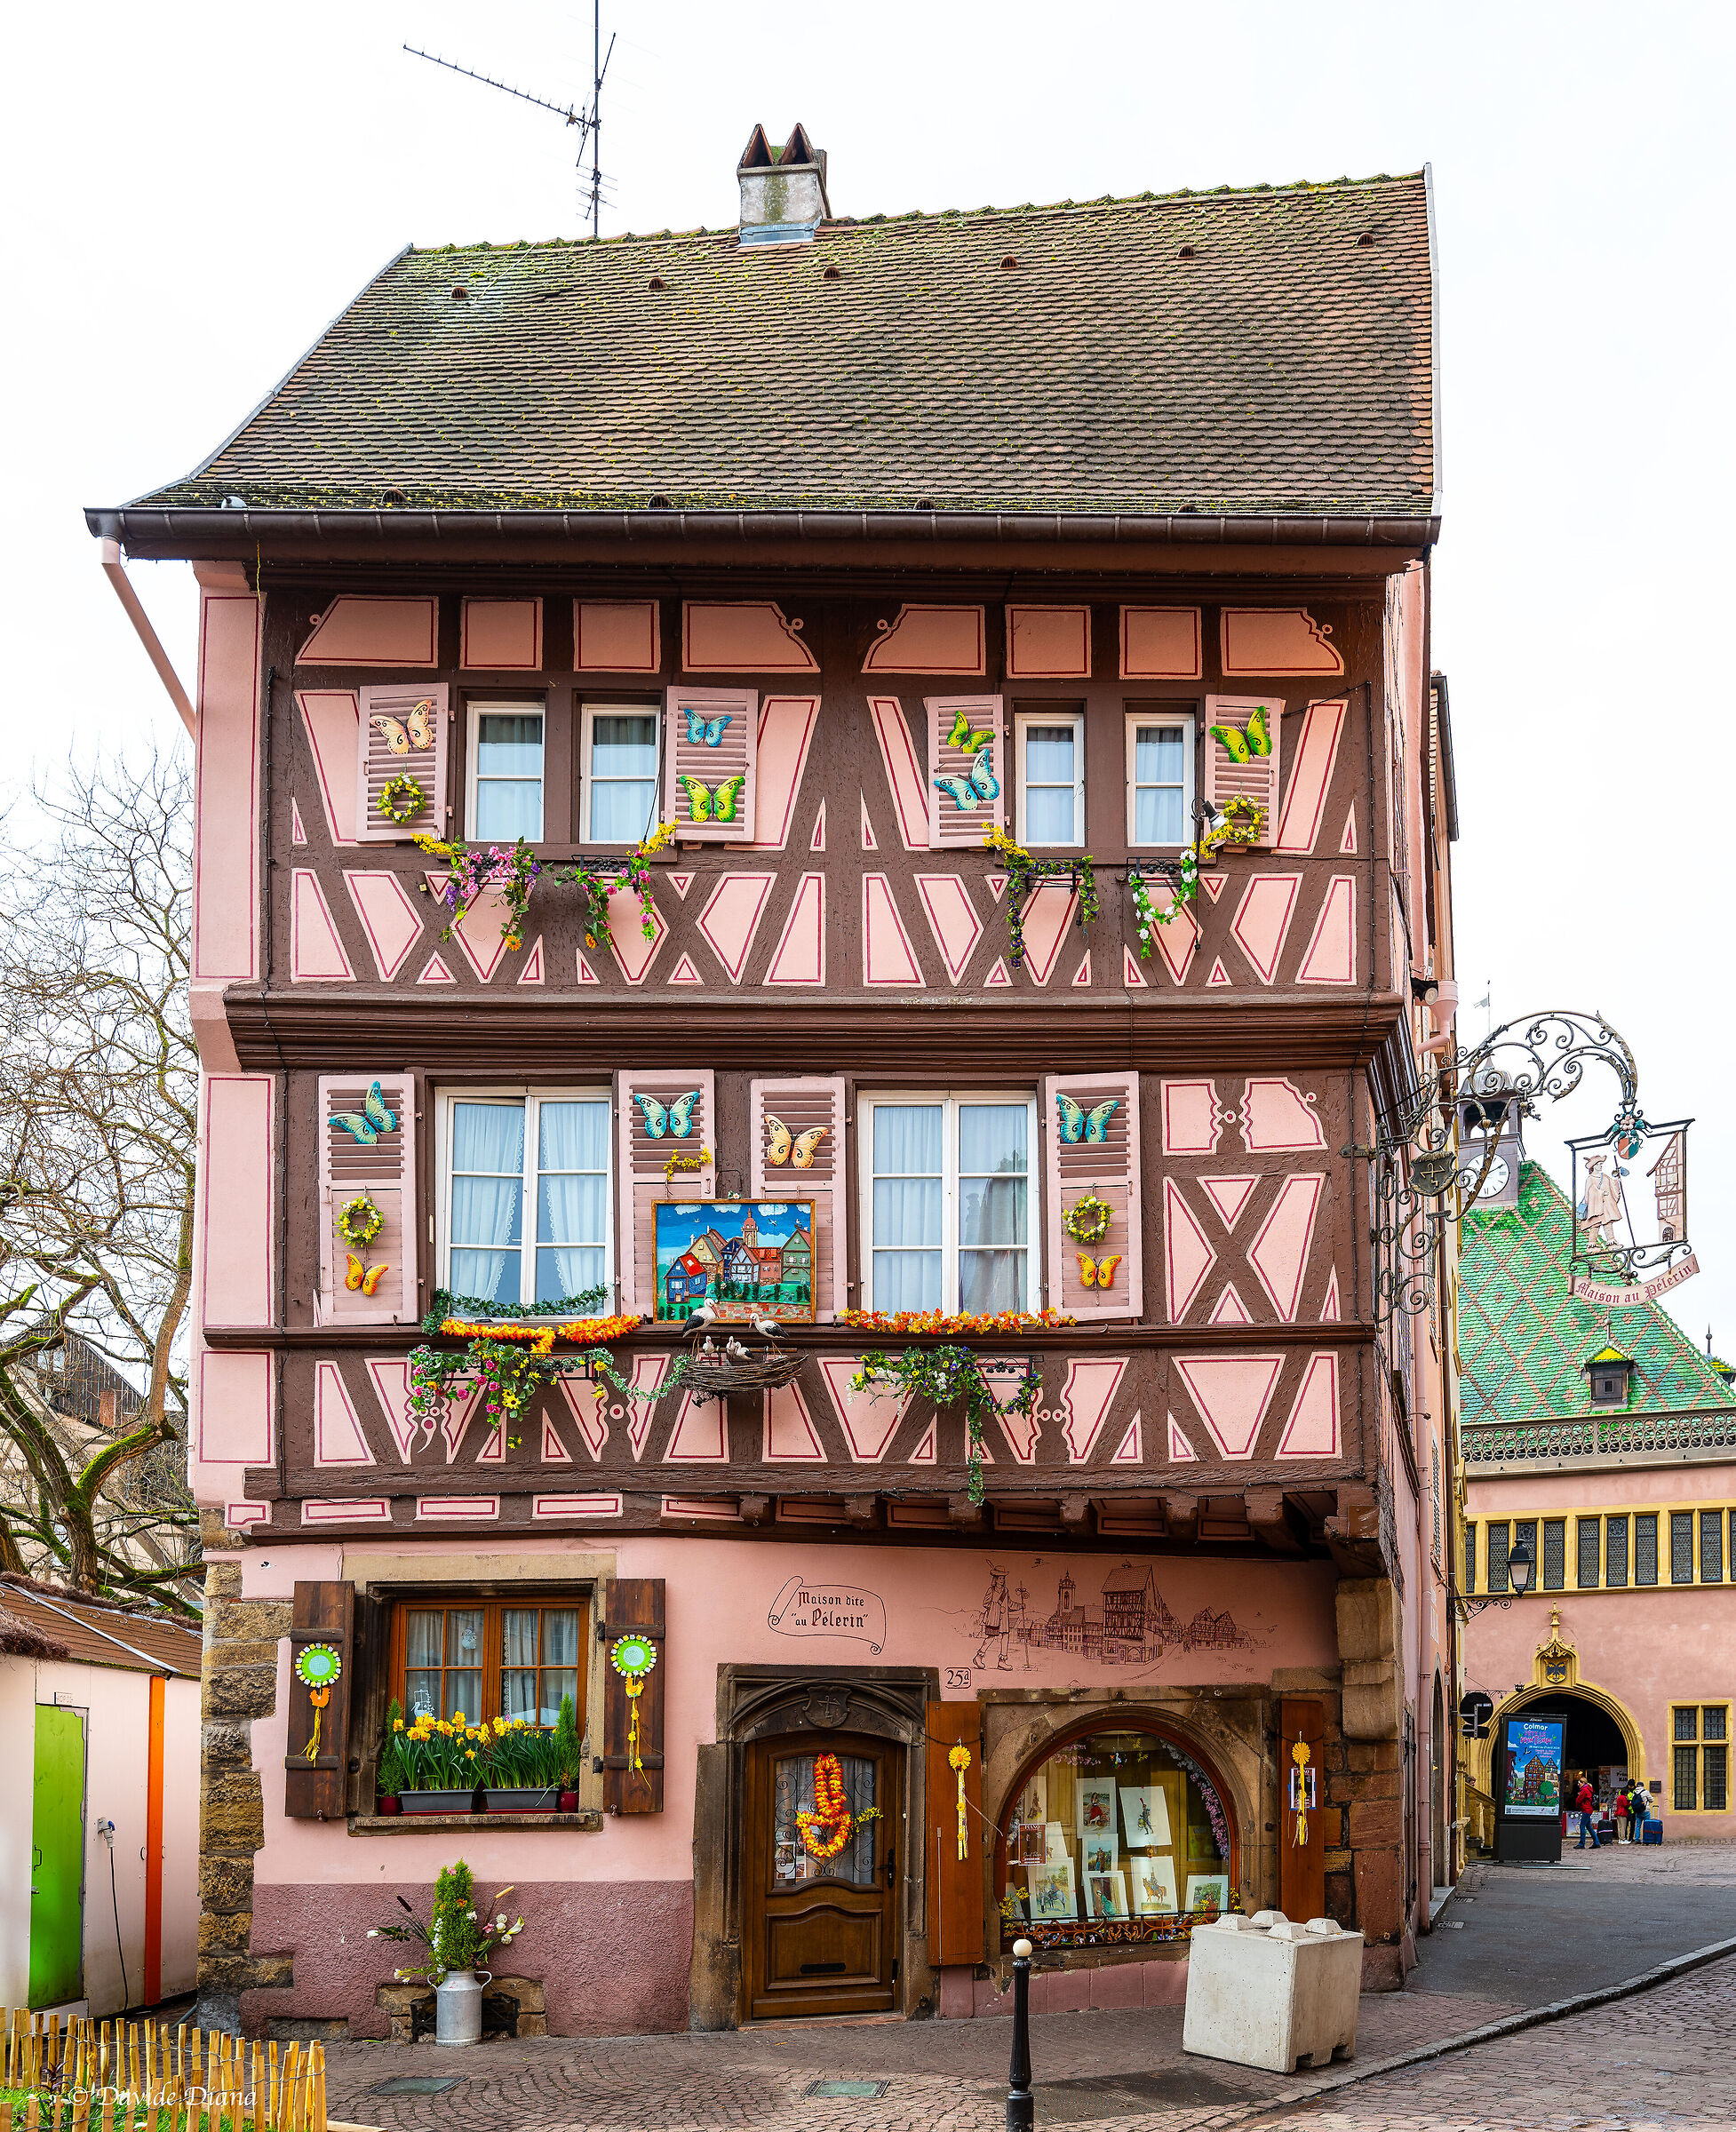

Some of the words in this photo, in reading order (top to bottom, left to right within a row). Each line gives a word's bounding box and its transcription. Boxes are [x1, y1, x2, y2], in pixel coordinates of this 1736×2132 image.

[1575, 1282, 1620, 1304] Maison
[1624, 1293, 1640, 1303] au
[1644, 1264, 1692, 1300] Pélerin
[797, 1591, 842, 1609] Maison
[846, 1595, 864, 1606] dite
